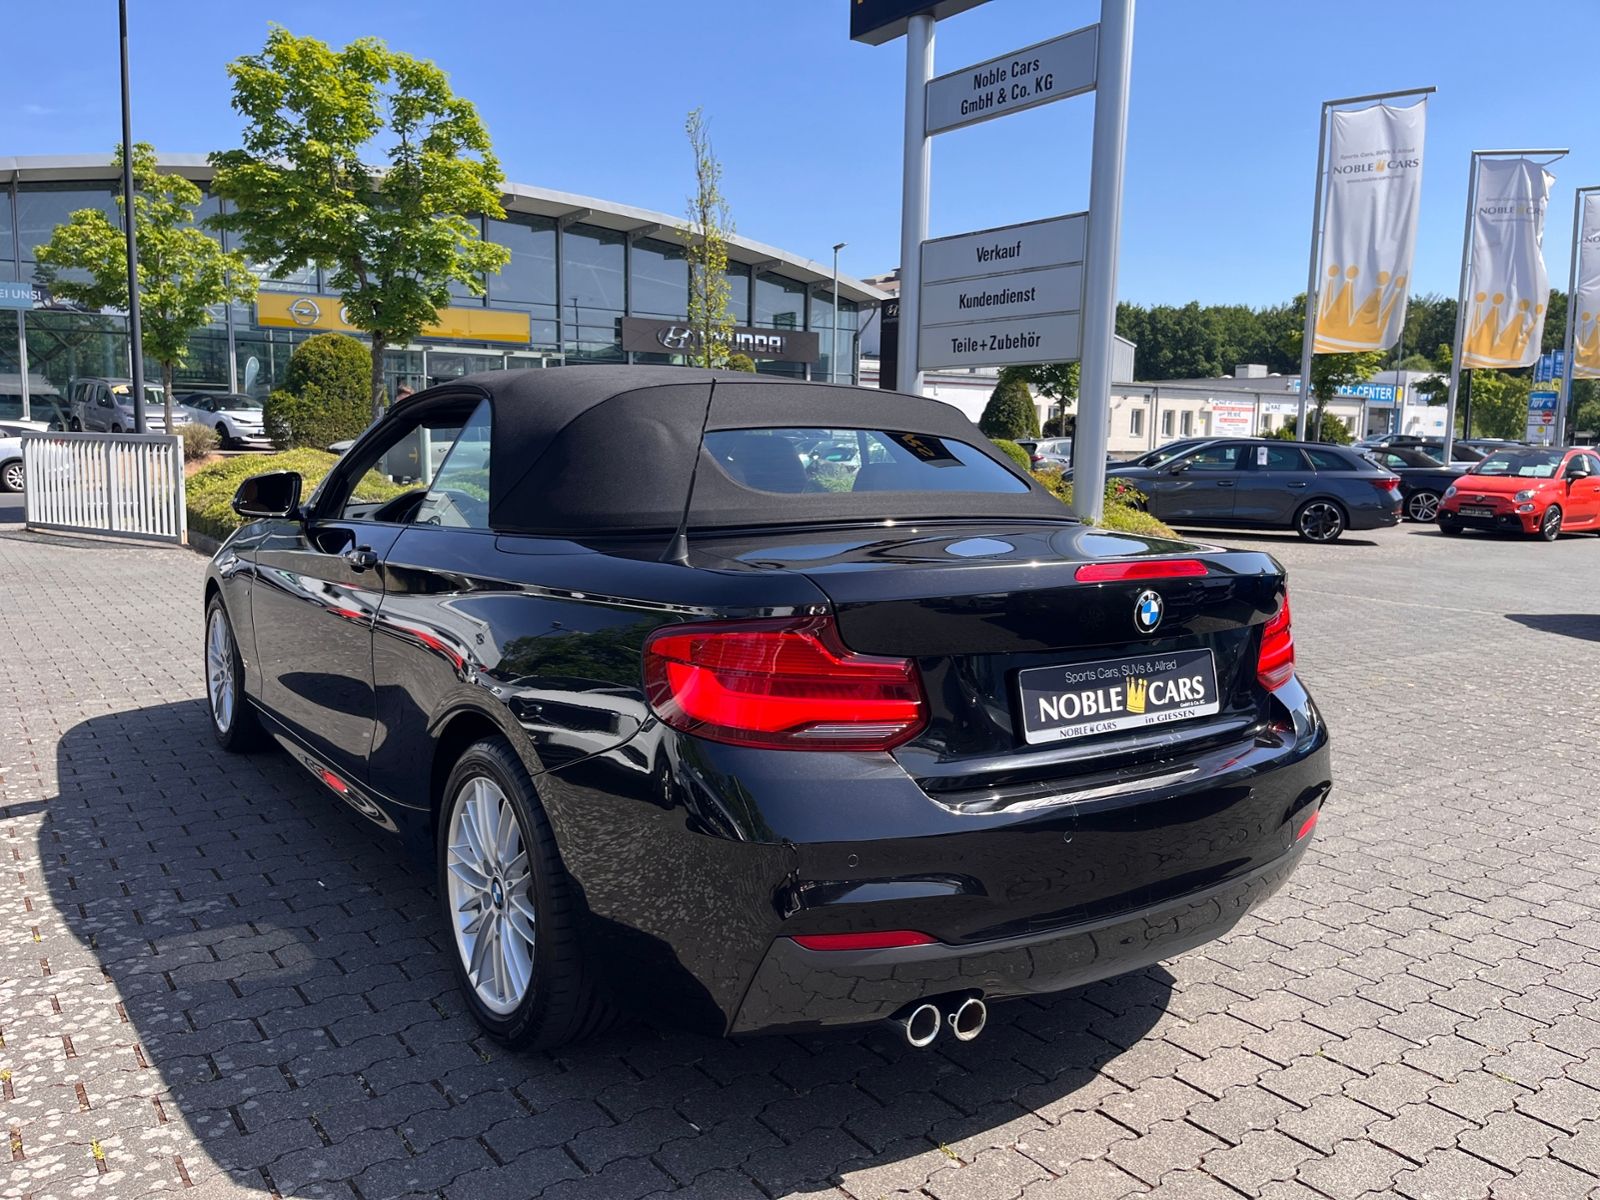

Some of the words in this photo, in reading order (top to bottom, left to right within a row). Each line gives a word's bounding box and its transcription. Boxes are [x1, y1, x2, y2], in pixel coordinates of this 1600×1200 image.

[973, 67, 1007, 90] Noble
[1011, 59, 1040, 78] Cars
[960, 92, 993, 115] GmbH
[997, 88, 1007, 105] &
[1011, 83, 1031, 101] Co.
[1035, 73, 1054, 93] KG
[1333, 162, 1375, 175] NOBLE
[1387, 158, 1420, 170] CARS
[1480, 206, 1515, 215] NOBLE
[976, 240, 1022, 263] Verkauf
[12, 289, 42, 300] UNS!
[958, 286, 1036, 310] Kundendienst
[951, 331, 1041, 354] Teile+Zubehör
[1065, 670, 1096, 685] Sports
[1097, 667, 1120, 679] Cars,
[1121, 664, 1145, 677] SUVs
[1146, 663, 1153, 673] &
[1154, 659, 1178, 672] Allrad
[1038, 687, 1124, 723] NOBLE
[1148, 675, 1206, 706] CARS
[1145, 715, 1155, 725] in
[1156, 709, 1196, 723] GIESSEN
[1059, 725, 1089, 739] NOBLE
[1095, 721, 1118, 732] CARS
